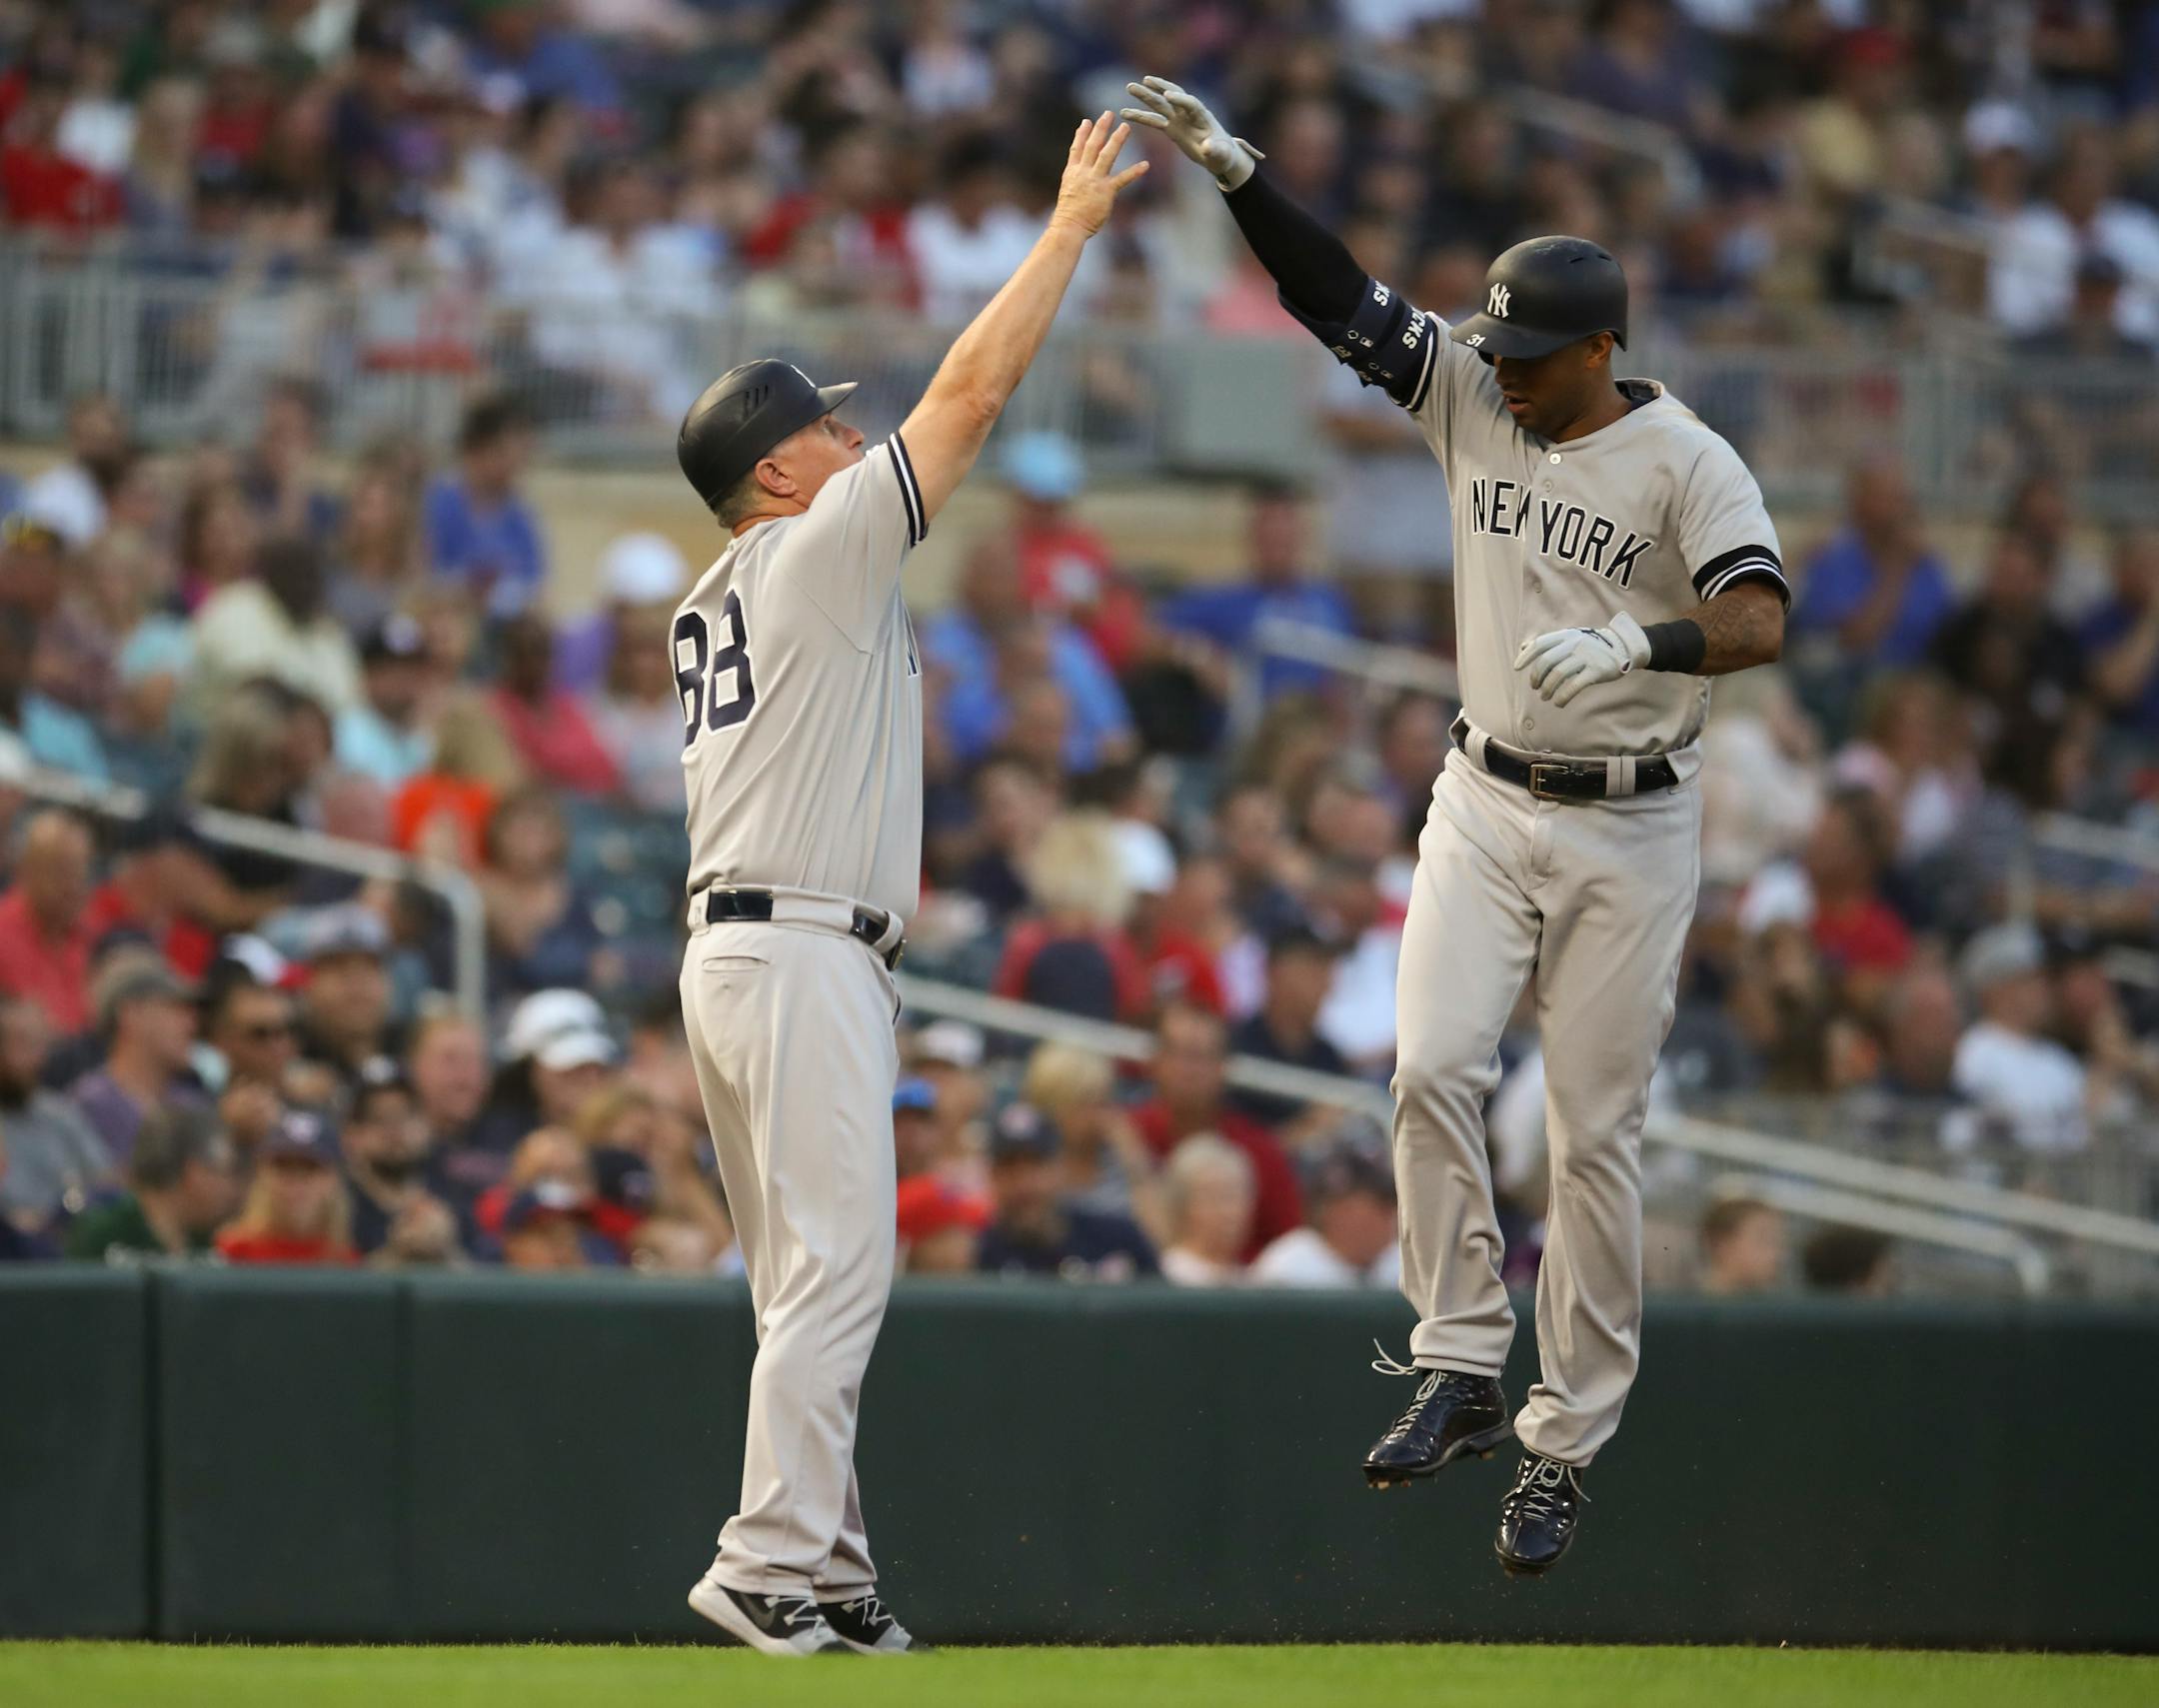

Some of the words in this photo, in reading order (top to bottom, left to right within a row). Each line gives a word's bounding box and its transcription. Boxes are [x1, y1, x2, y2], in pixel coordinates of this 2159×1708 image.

[1486, 282, 1511, 319] NY
[1465, 333, 1486, 348] 31
[1538, 498, 1654, 590] YORK
[673, 585, 759, 749] 88
